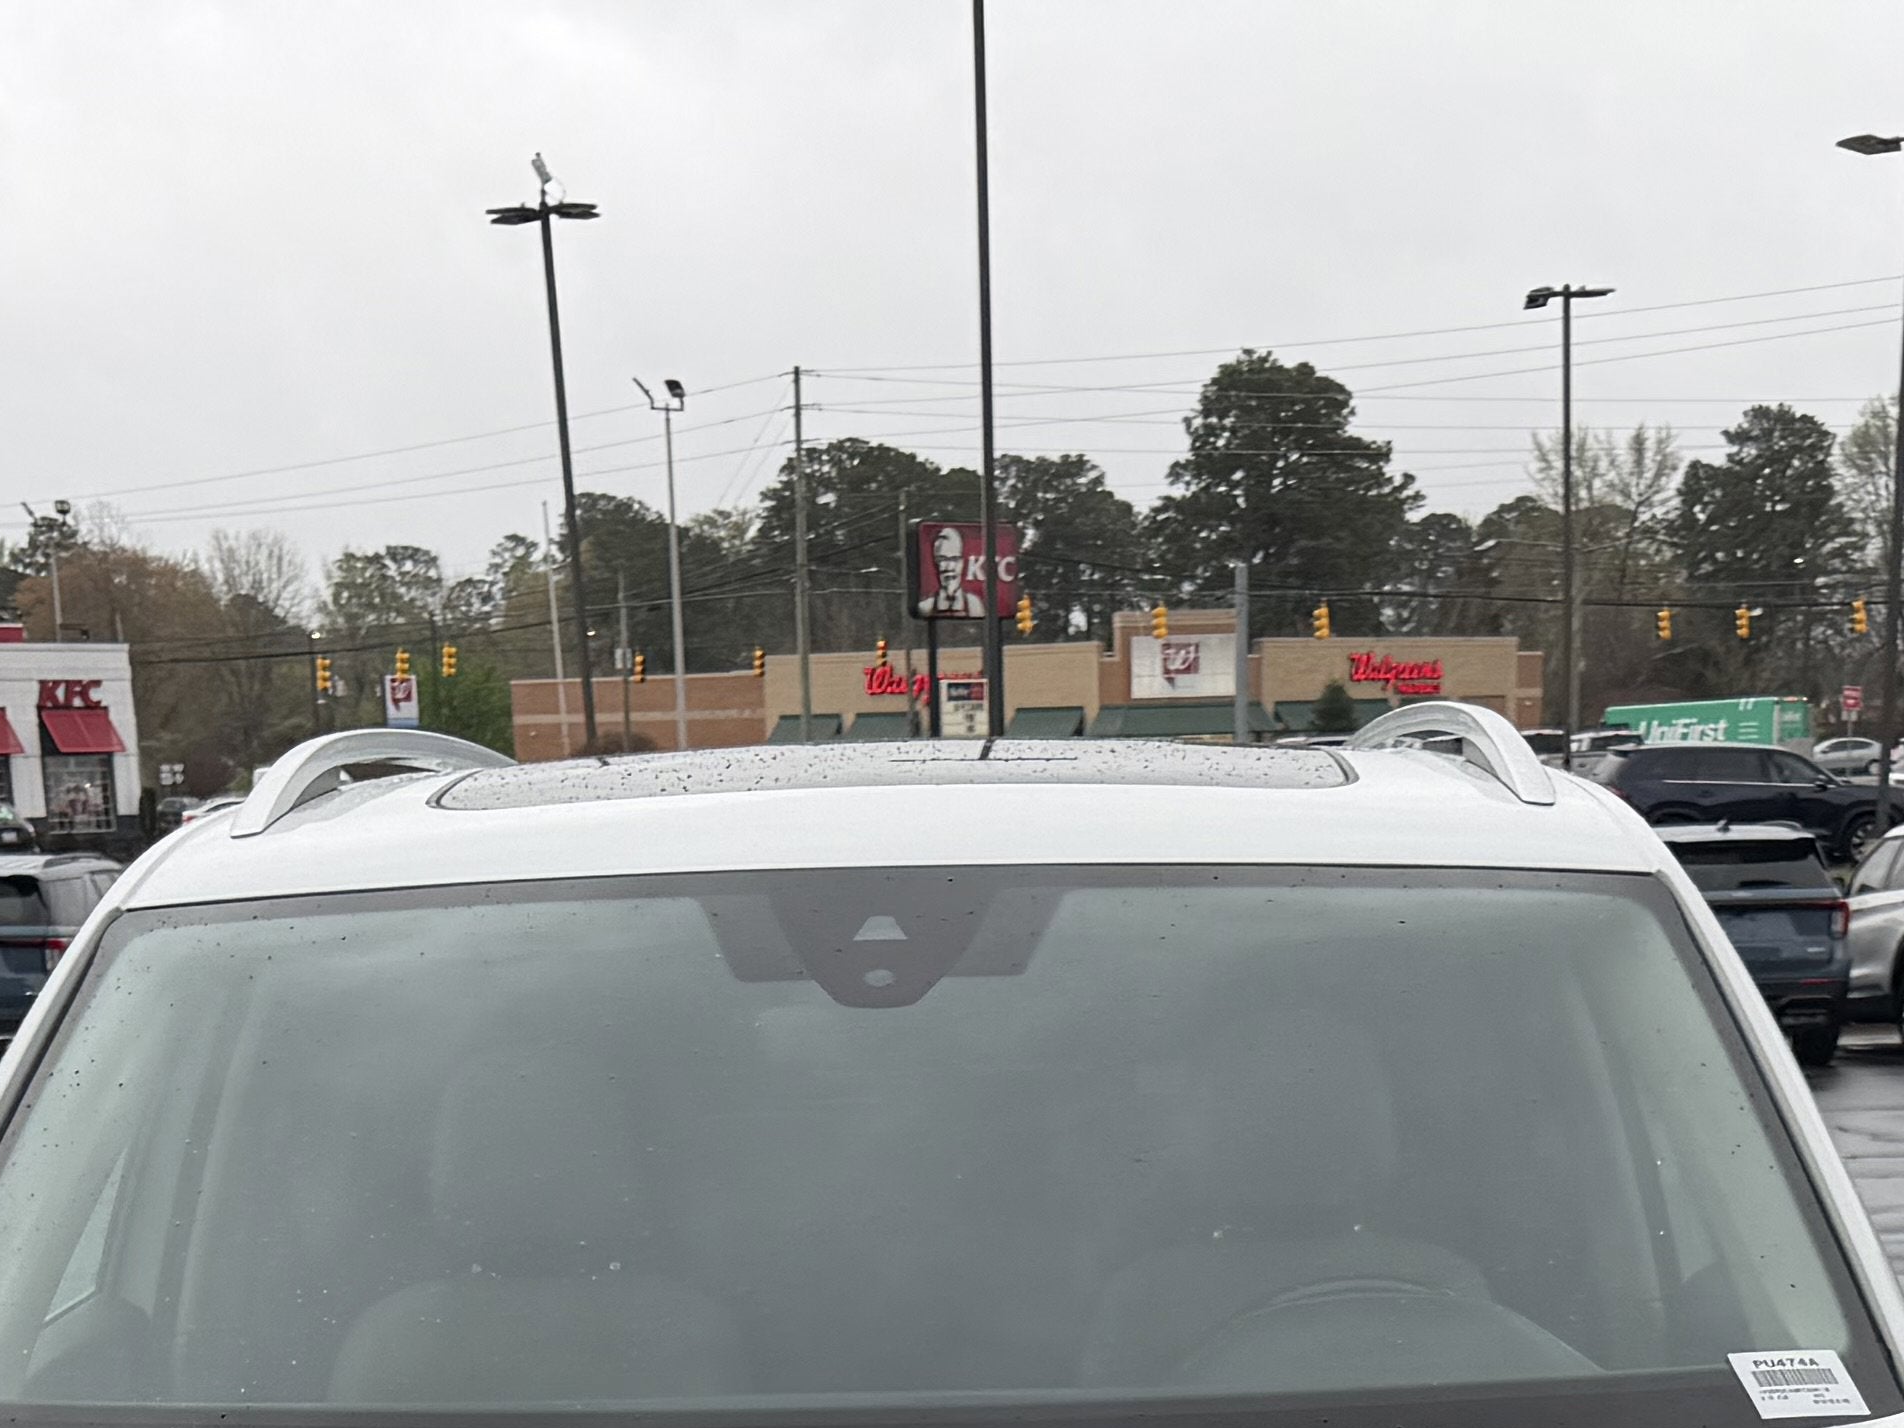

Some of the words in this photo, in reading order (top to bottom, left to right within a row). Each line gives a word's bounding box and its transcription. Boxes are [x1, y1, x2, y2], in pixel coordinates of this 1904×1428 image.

[966, 555, 1016, 582] KC
[38, 680, 103, 707] KFC
[1640, 717, 1729, 742] UniFirst
